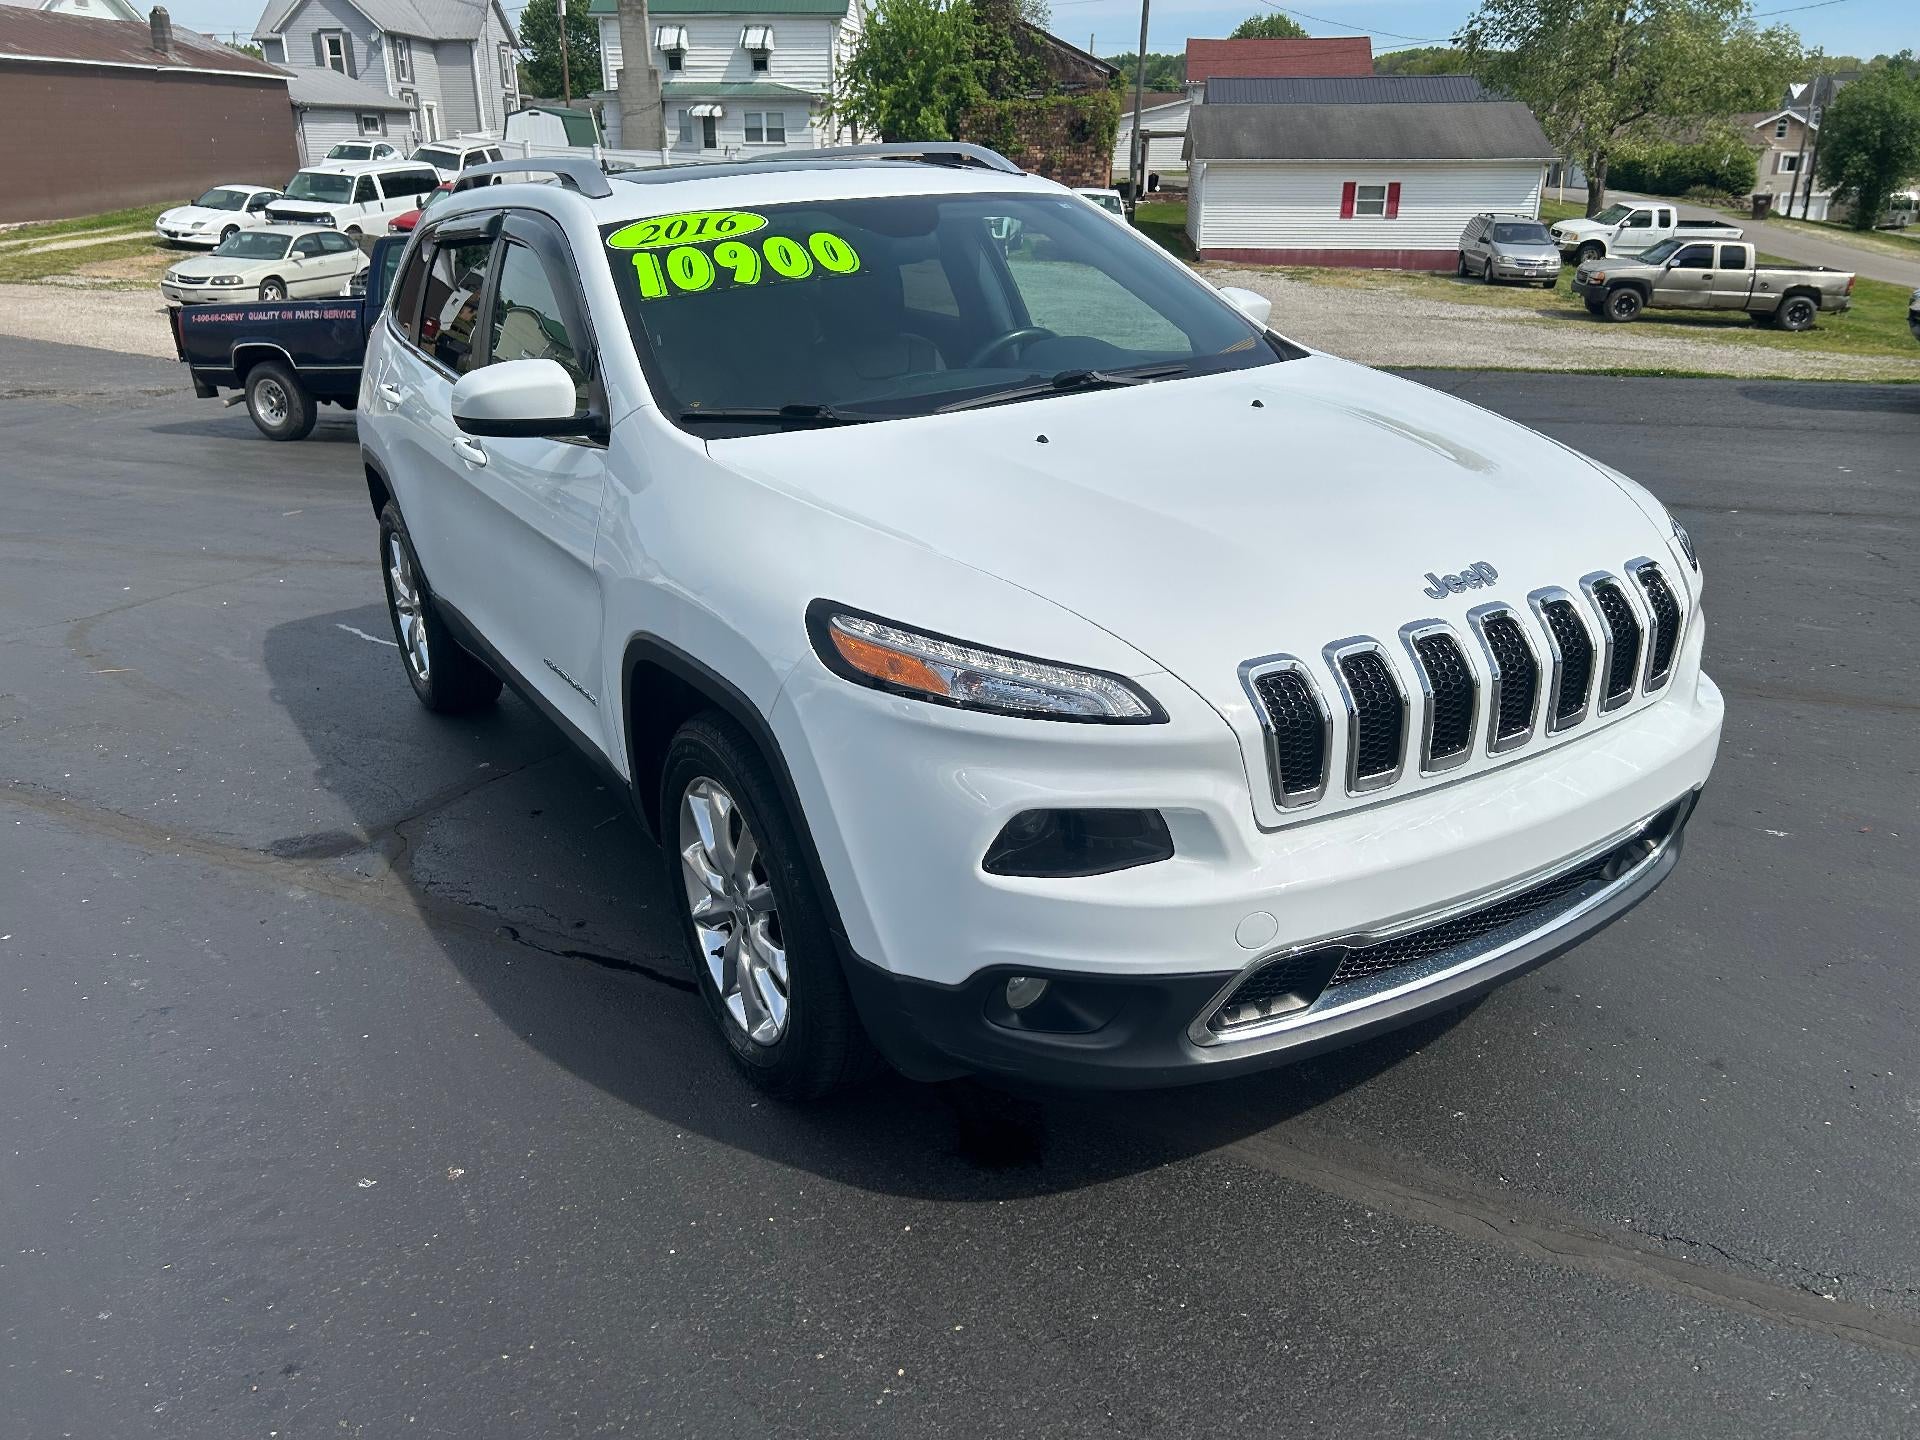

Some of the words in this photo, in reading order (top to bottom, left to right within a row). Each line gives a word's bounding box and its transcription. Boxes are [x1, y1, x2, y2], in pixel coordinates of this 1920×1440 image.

[637, 215, 737, 246] 2016
[632, 232, 860, 299] 10900
[248, 310, 280, 320] QUALITY
[281, 311, 293, 319] GM
[1423, 561, 1499, 600] Jeep
